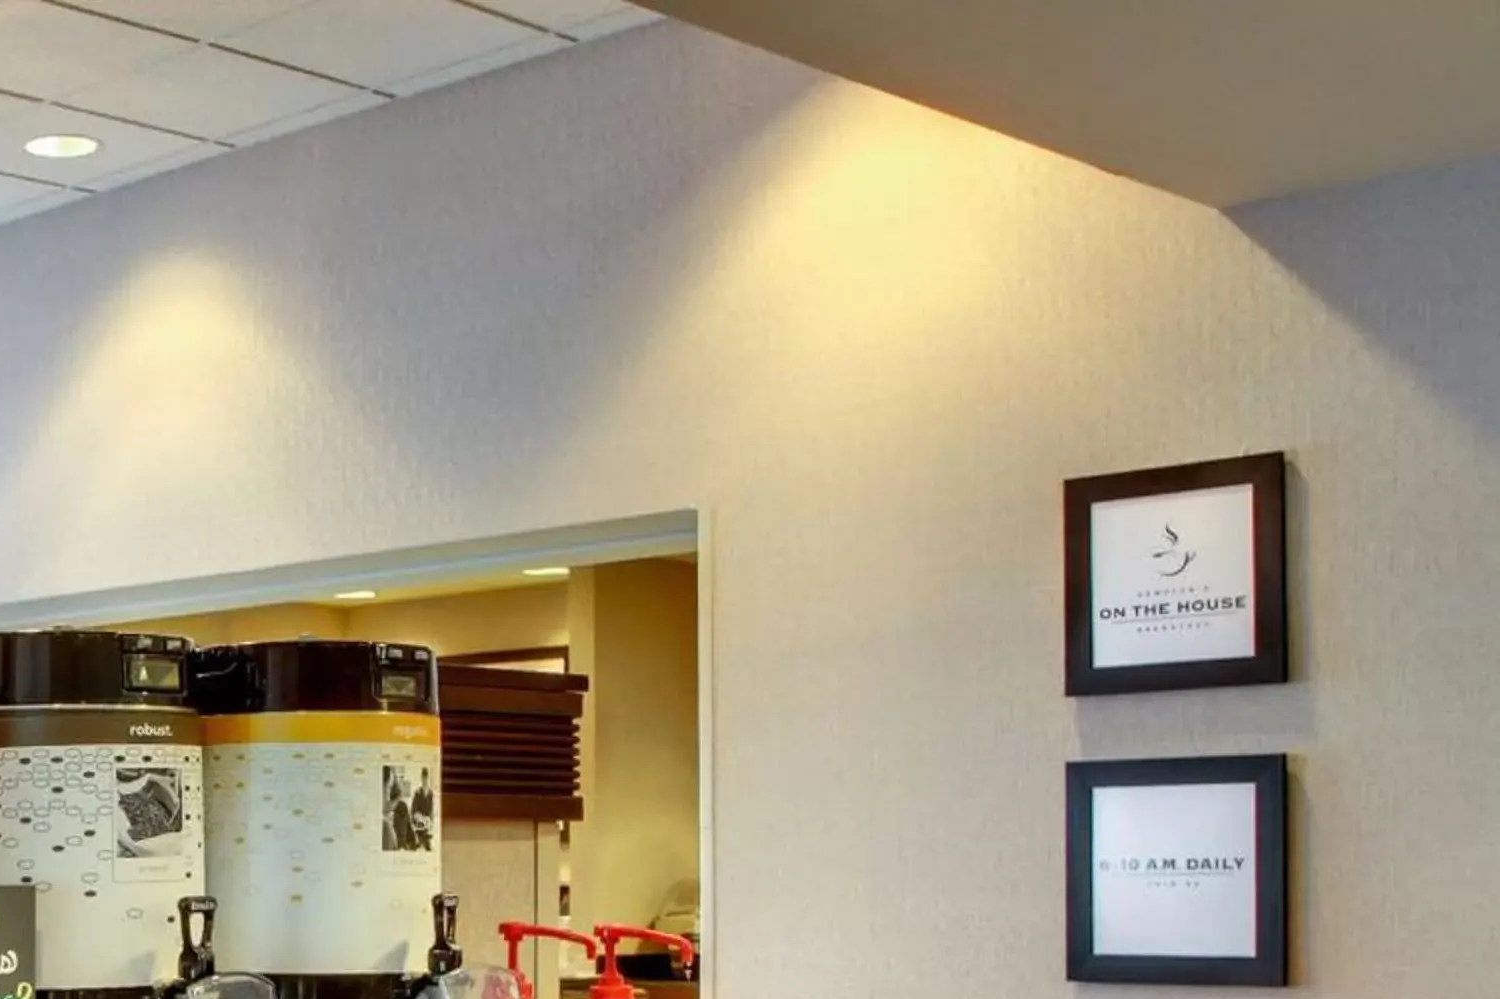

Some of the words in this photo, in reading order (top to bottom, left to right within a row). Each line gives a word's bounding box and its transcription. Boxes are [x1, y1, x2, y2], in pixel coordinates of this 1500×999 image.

[1099, 607, 1127, 620] ON
[1132, 602, 1171, 618] THE
[1177, 594, 1247, 614] HOUSE
[129, 722, 173, 738] robust.
[1186, 857, 1246, 871] DAILY
